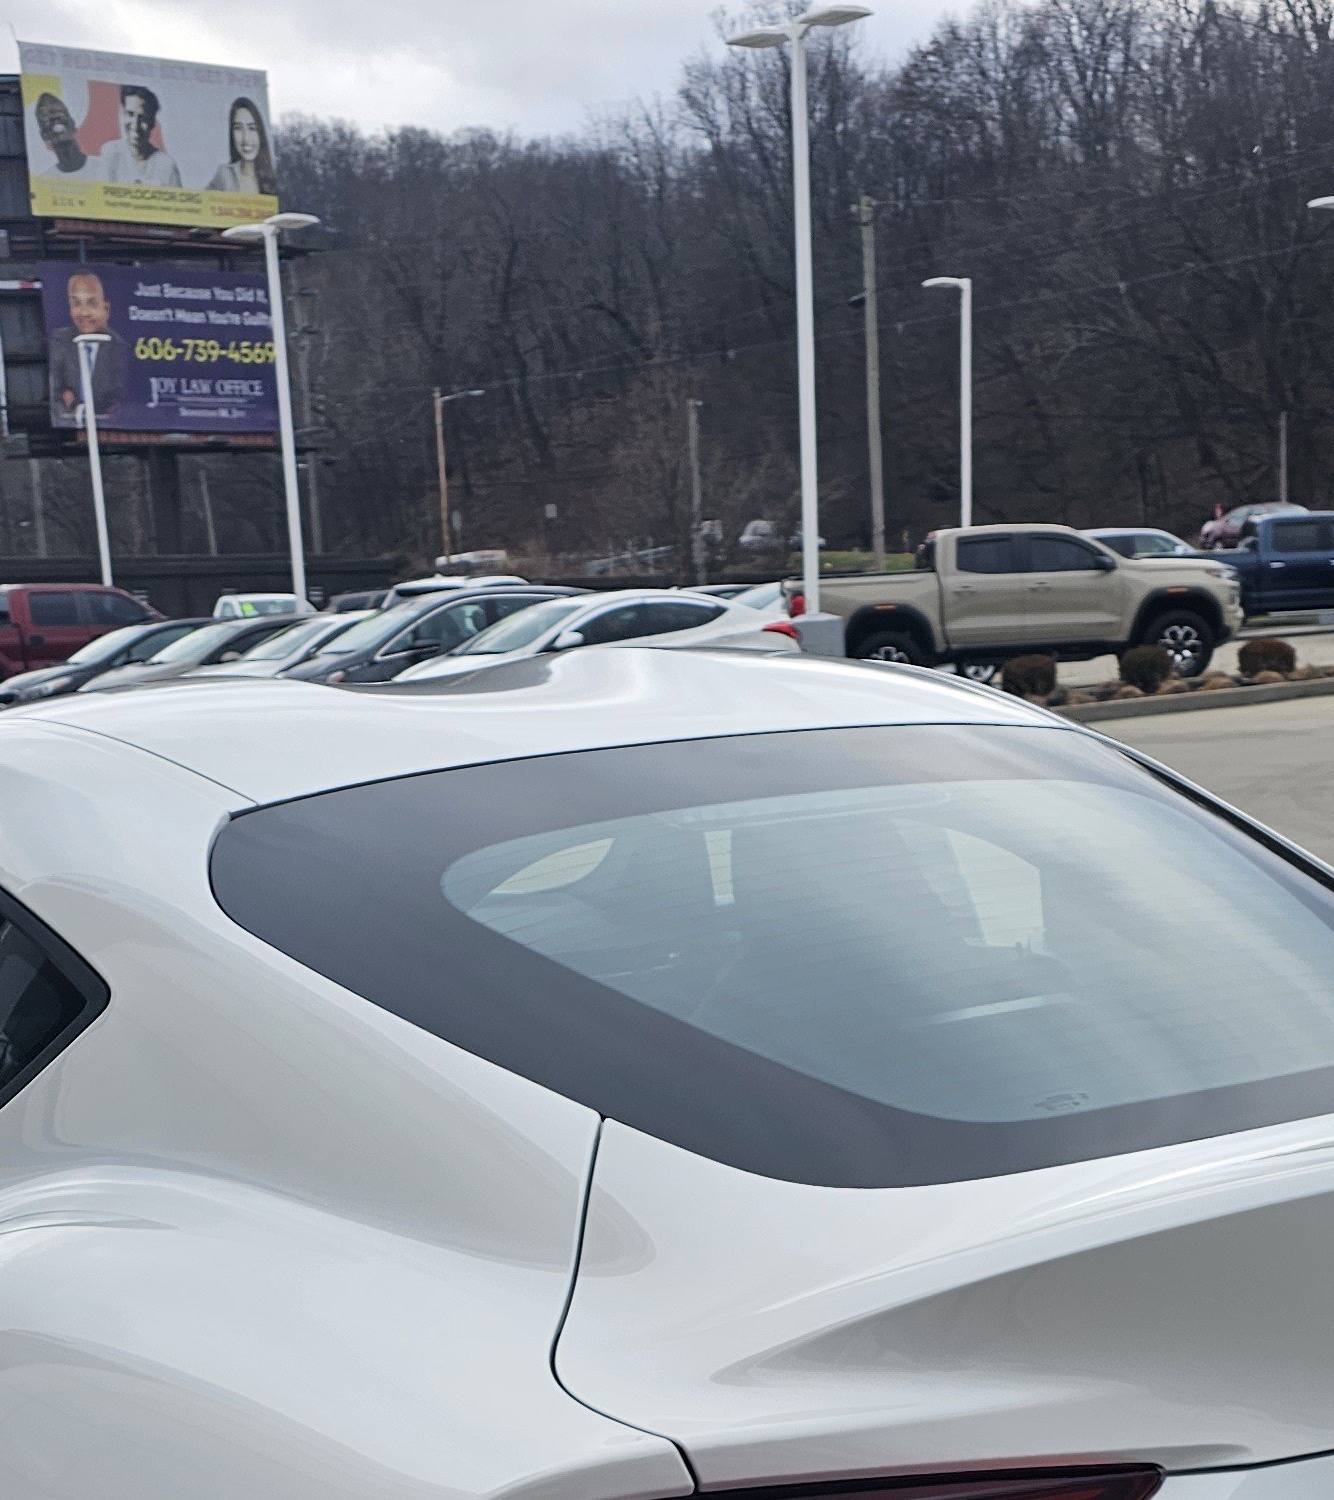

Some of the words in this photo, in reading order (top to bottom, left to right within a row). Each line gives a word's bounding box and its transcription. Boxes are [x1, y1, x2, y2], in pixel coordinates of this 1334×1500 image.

[134, 282, 162, 297] Just
[163, 283, 212, 300] Because
[213, 286, 235, 301] You
[175, 308, 206, 324] Mean
[242, 311, 273, 327] Guilt
[135, 337, 276, 363] 606-739-4569
[180, 378, 213, 394] LAW
[215, 380, 264, 396] OFFICE
